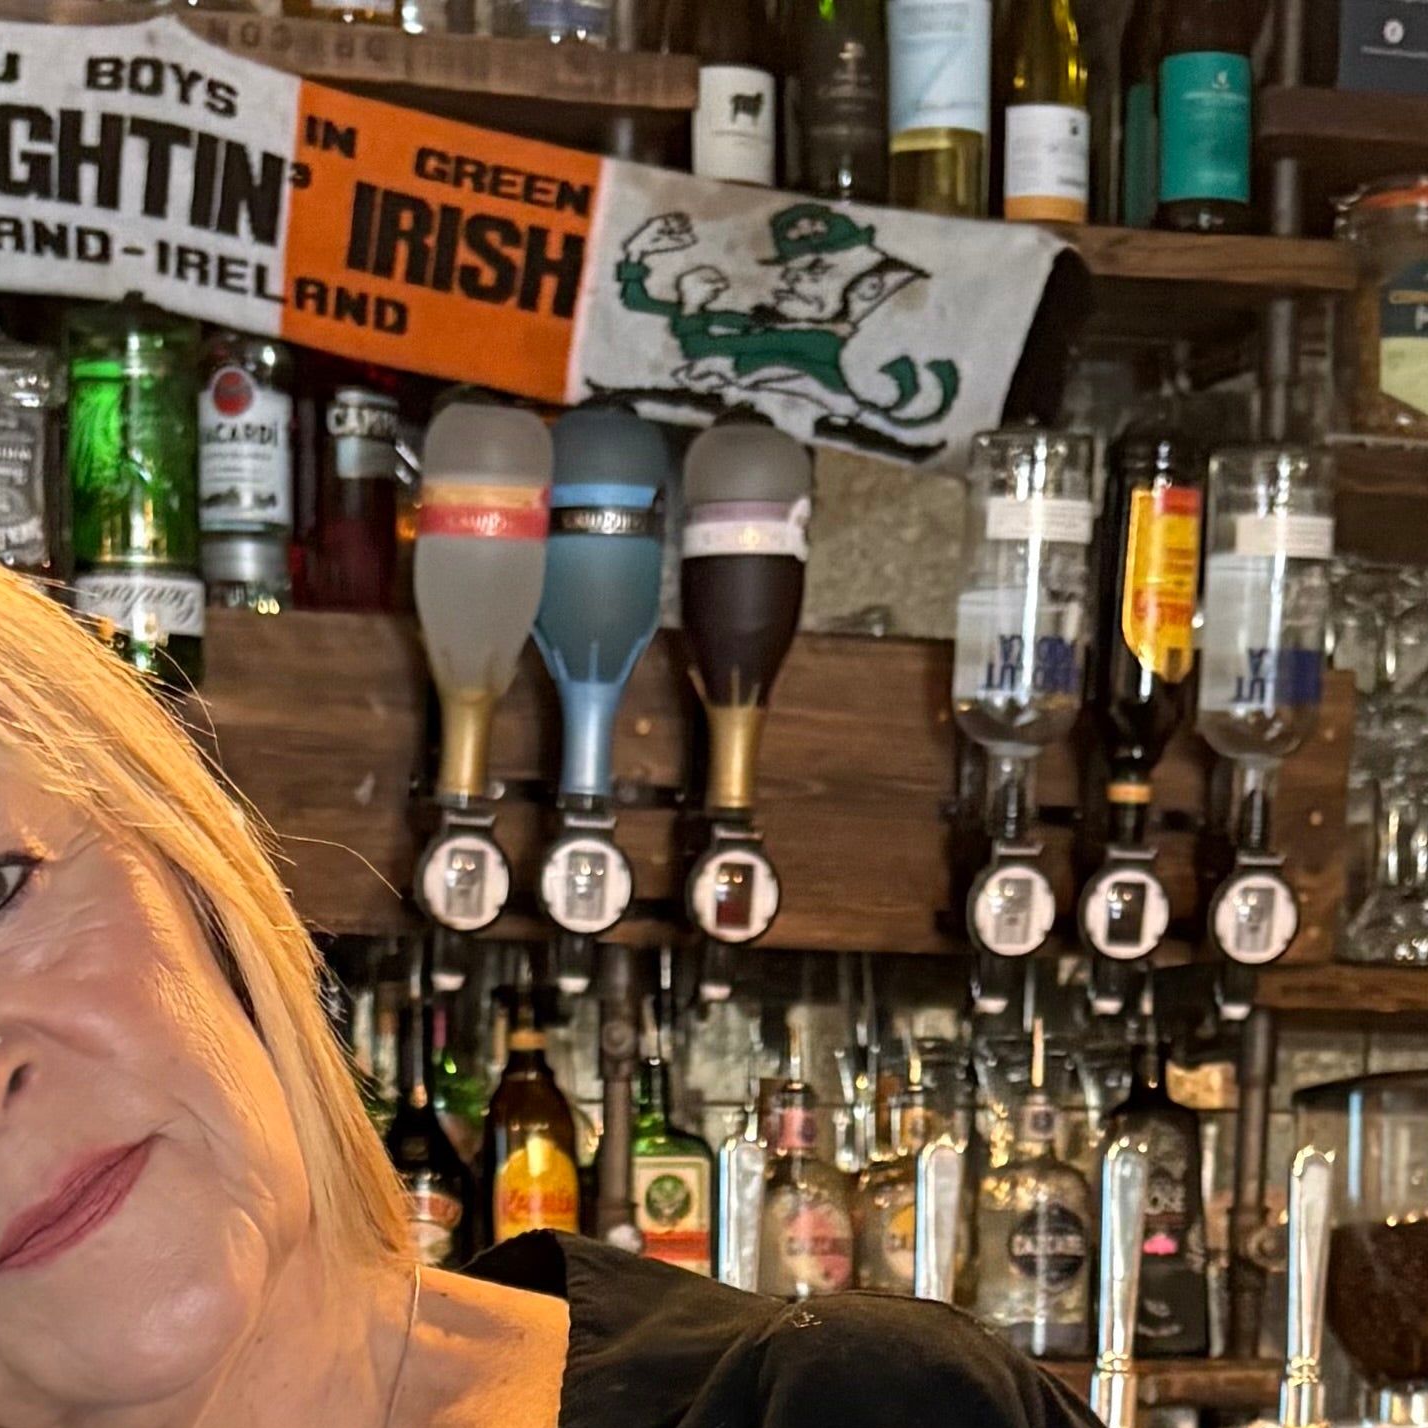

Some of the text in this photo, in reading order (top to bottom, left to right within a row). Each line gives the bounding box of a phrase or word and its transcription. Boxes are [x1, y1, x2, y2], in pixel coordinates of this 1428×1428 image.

[86, 55, 239, 118] BOYS
[305, 115, 358, 159] IN
[414, 146, 593, 216] GREEN
[346, 181, 586, 319] IRISH
